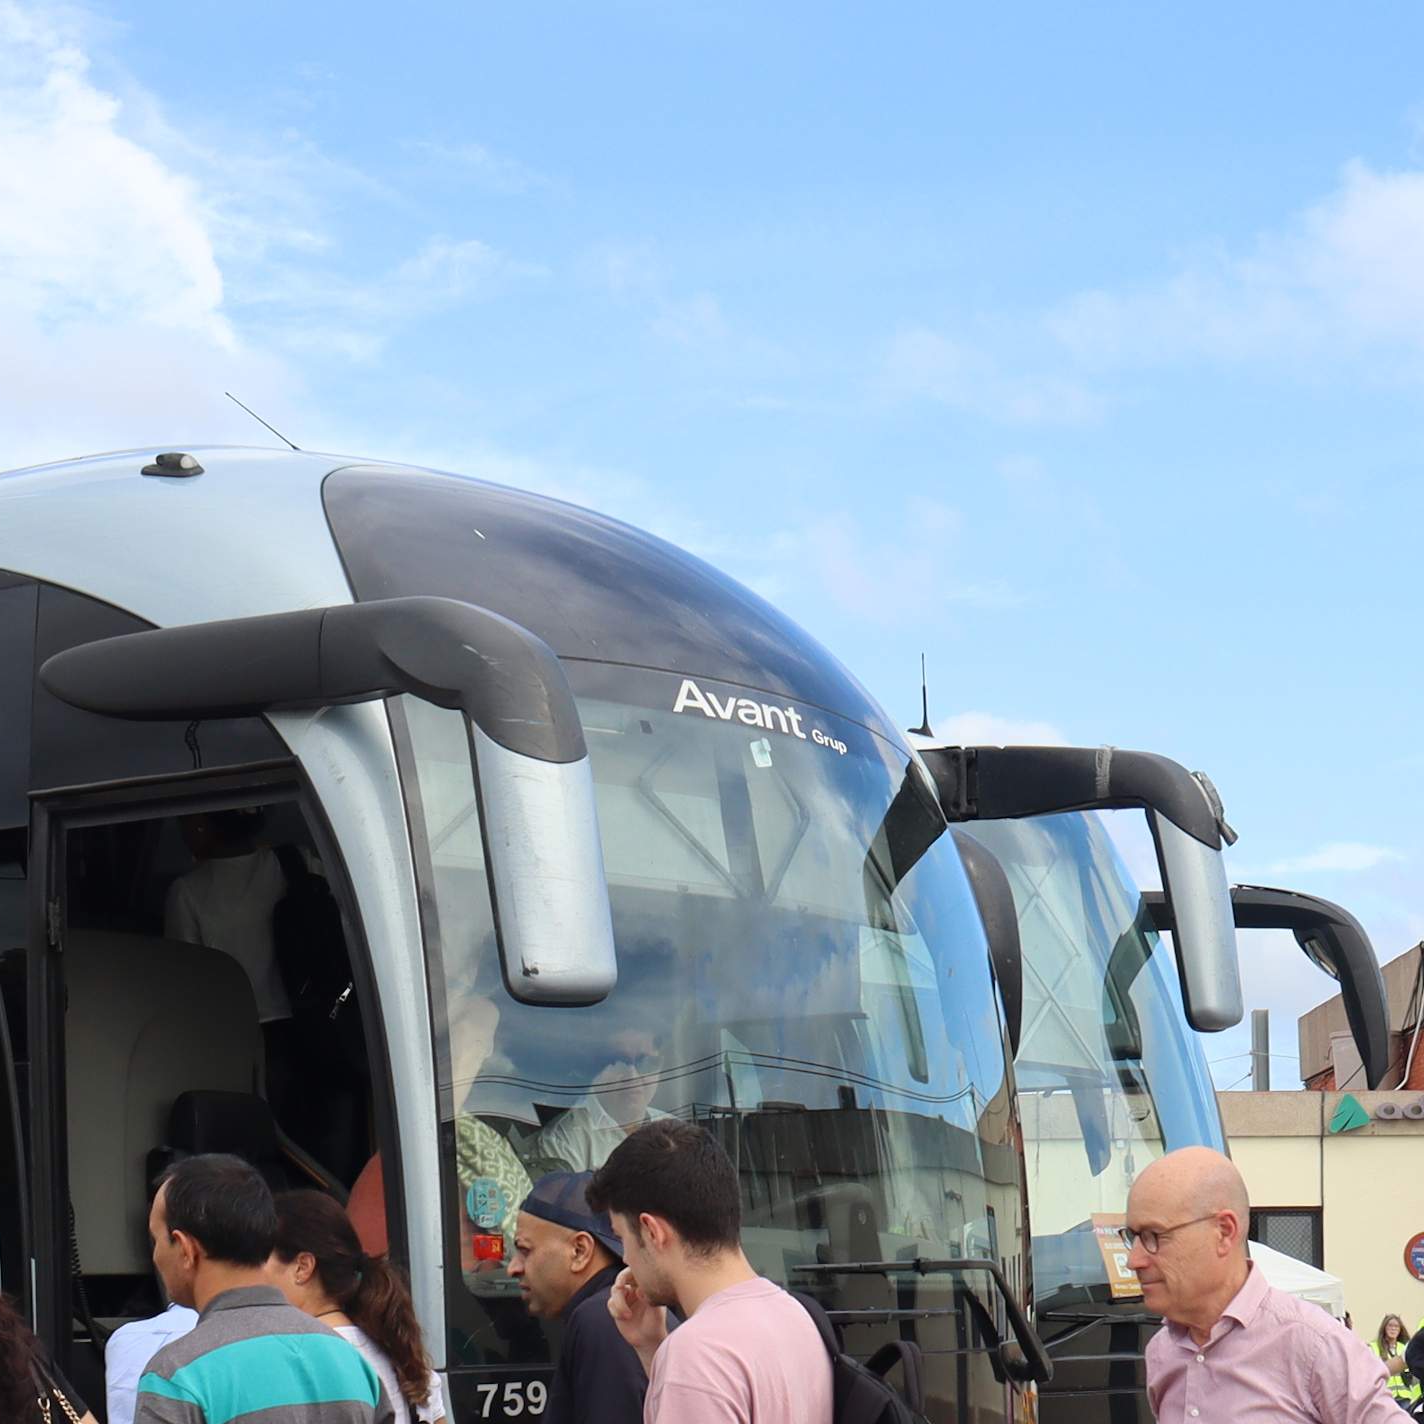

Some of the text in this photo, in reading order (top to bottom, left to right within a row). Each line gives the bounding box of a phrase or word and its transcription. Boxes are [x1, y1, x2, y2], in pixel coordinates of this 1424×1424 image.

[672, 679, 848, 756] Avant Grup
[476, 1380, 548, 1418] 759
